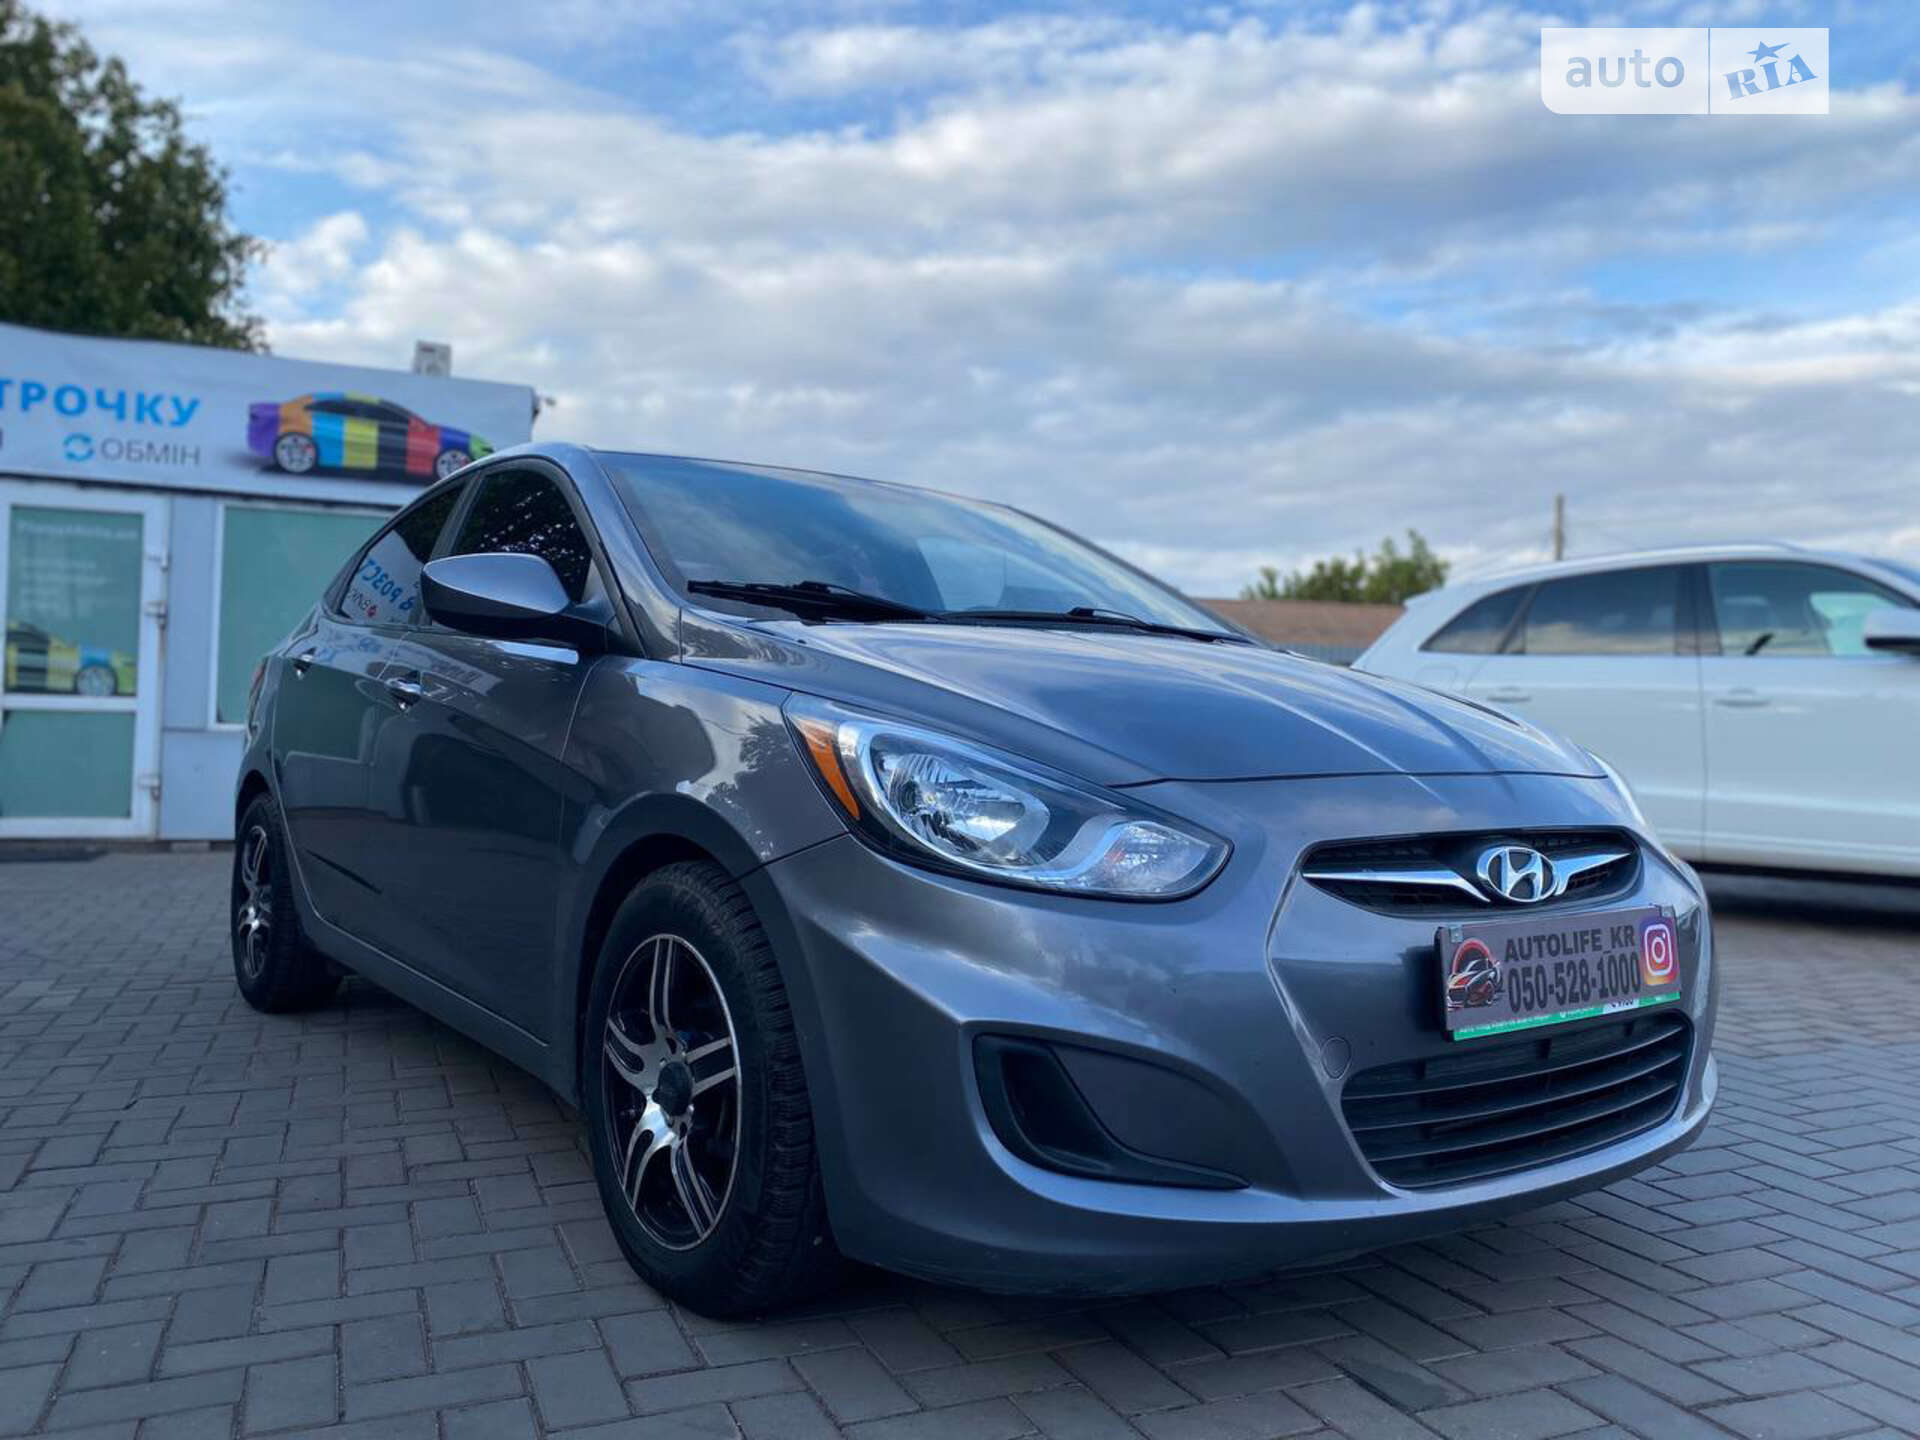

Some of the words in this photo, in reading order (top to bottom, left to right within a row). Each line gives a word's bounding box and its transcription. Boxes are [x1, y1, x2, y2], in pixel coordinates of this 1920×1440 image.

[101, 437, 201, 465] ОБМІН
[1504, 925, 1636, 962] AUTOLIFE_KR
[1508, 951, 1641, 1013] 050-528-1000
